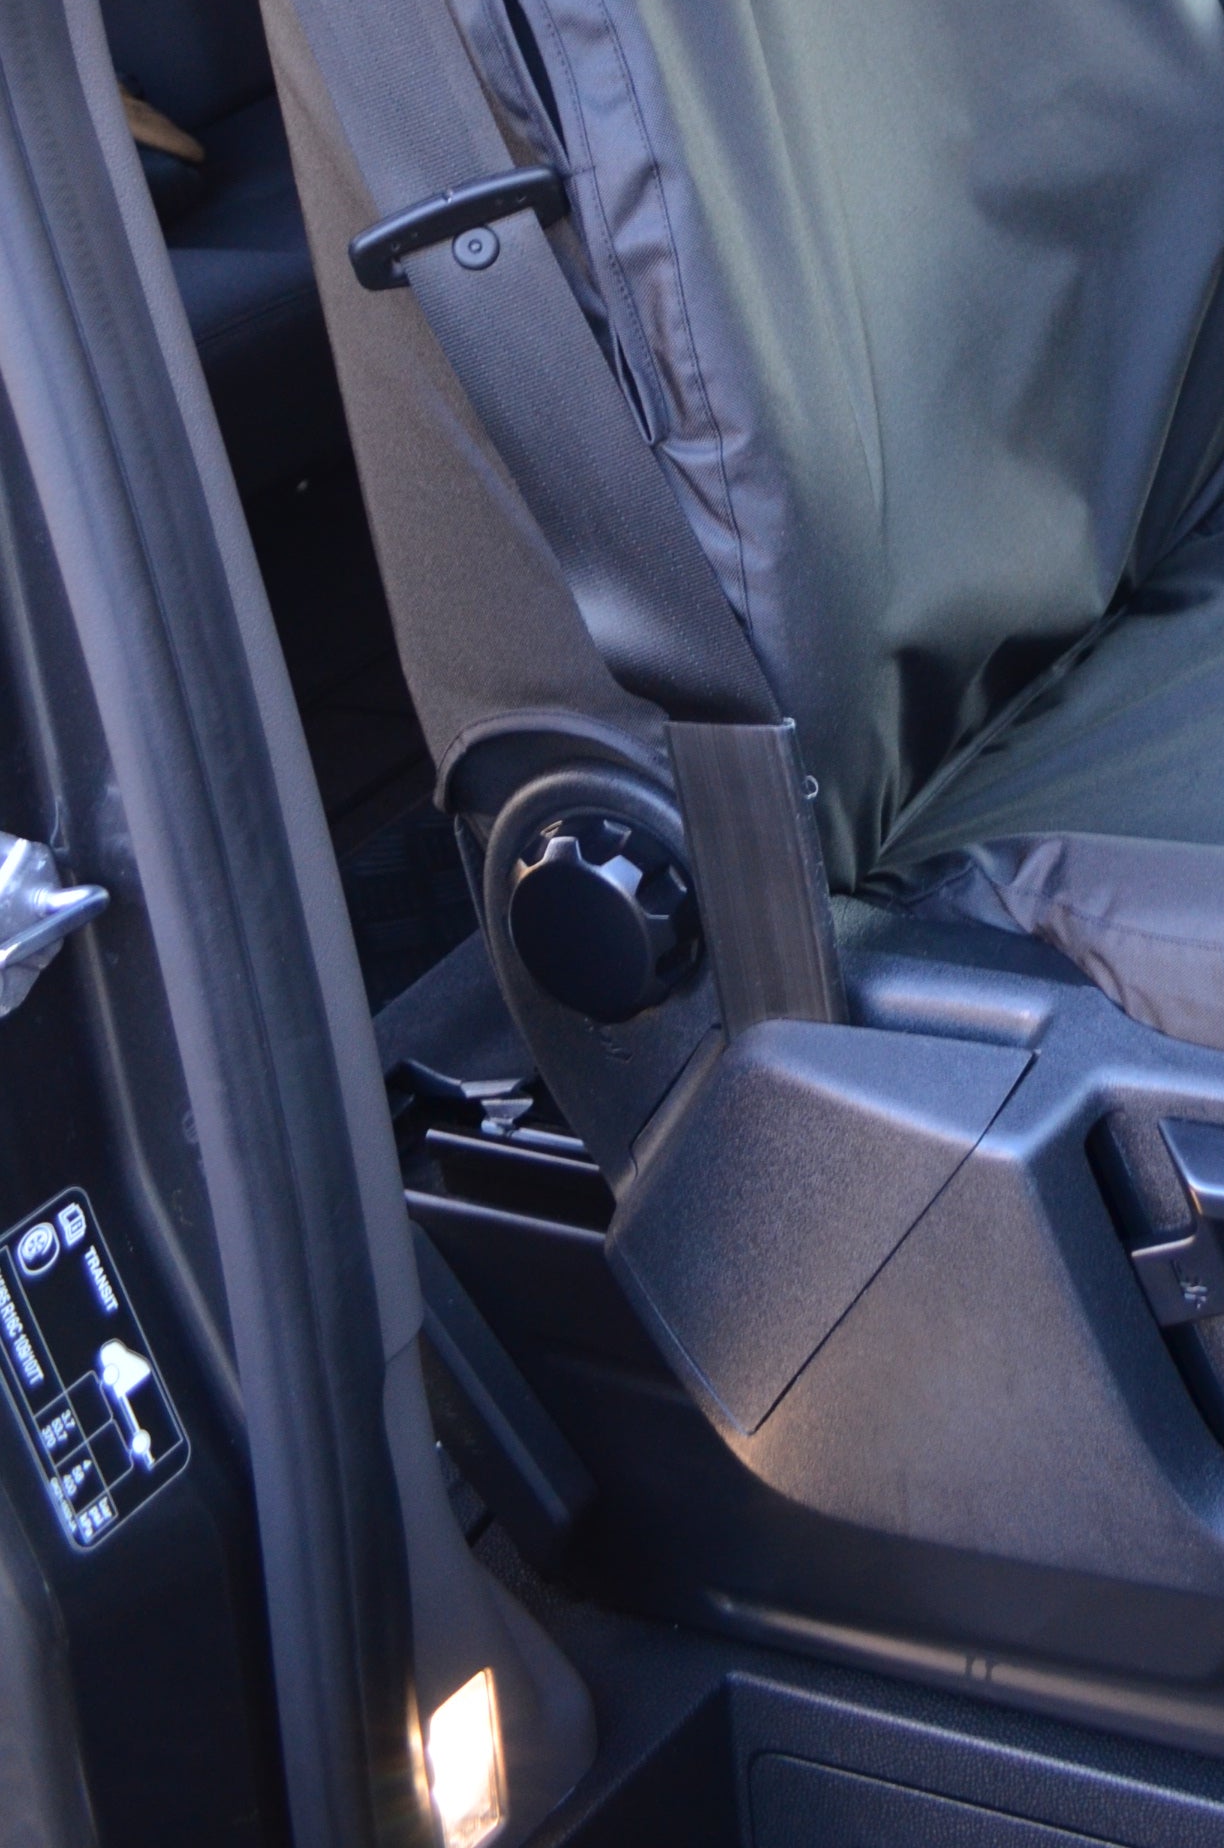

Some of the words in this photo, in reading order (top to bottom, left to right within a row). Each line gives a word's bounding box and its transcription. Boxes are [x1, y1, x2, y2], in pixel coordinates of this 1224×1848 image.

[85, 1245, 119, 1312] TRANSIT
[1, 1301, 23, 1337] R16C
[15, 1333, 44, 1384] 109/107T
[41, 1425, 56, 1449] 370
[61, 1408, 76, 1428] 3.7
